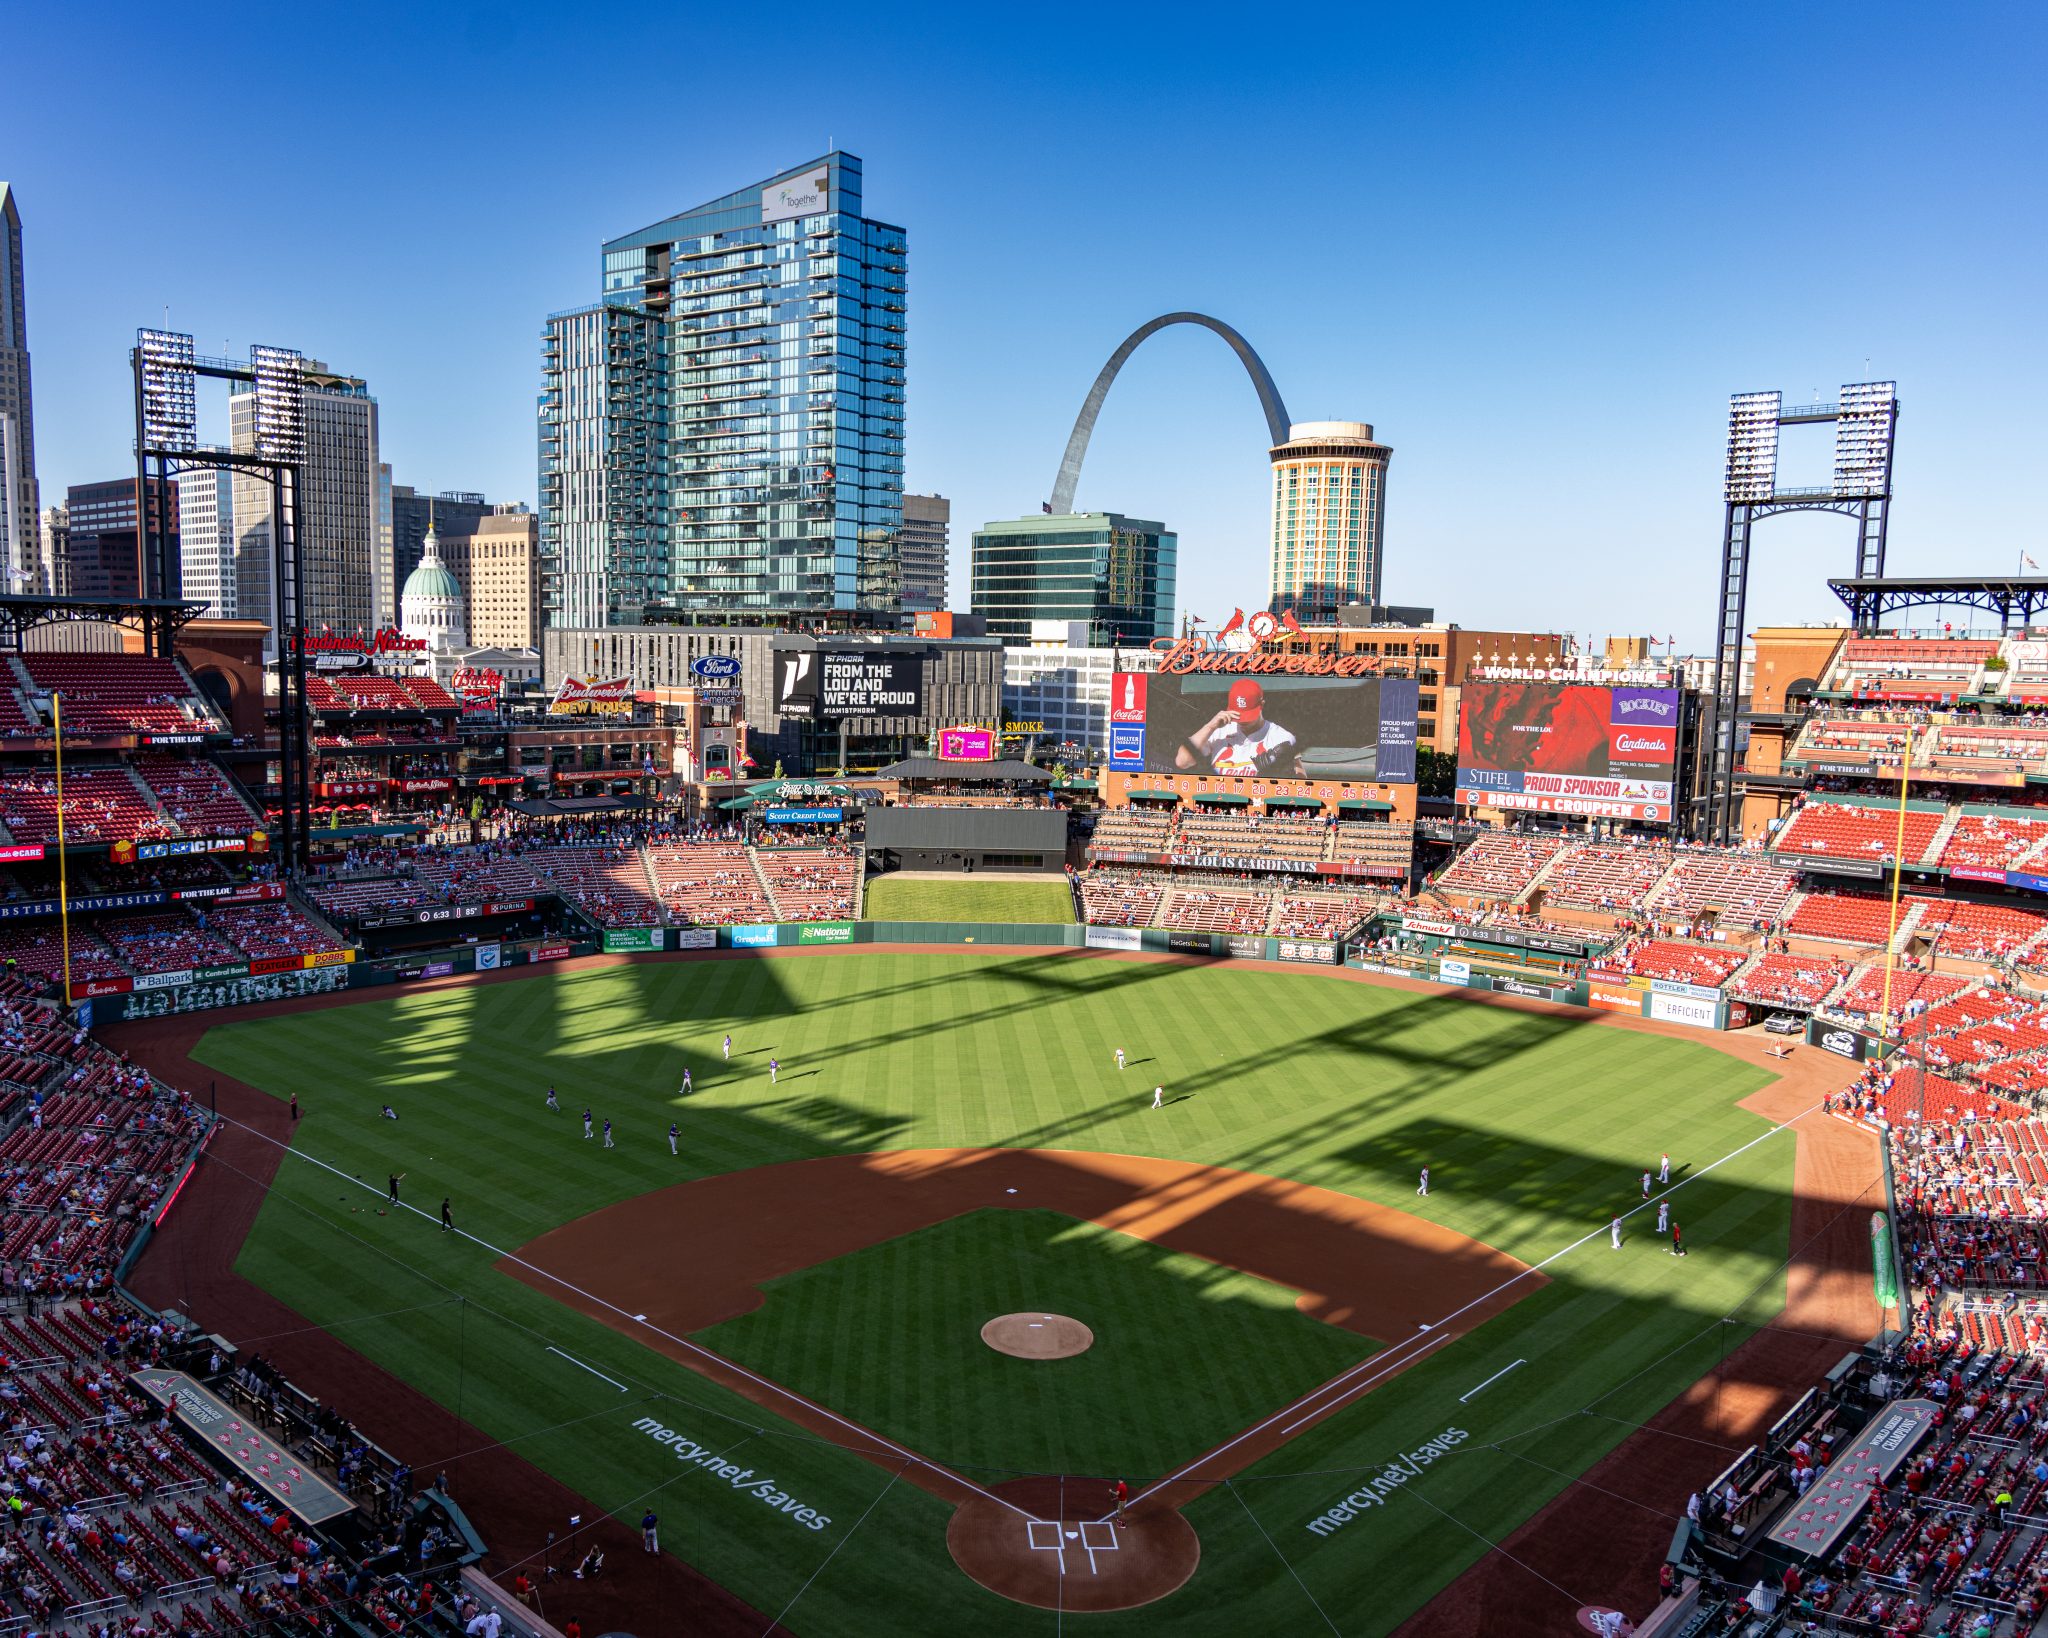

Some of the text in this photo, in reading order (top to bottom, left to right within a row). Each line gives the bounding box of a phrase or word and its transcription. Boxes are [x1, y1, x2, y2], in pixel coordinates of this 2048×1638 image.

[786, 195, 816, 208] Together
[365, 629, 427, 655] Nation
[1150, 637, 1382, 674] Budweiser
[703, 658, 734, 674] Ford
[824, 665, 892, 677] FROM THE
[1484, 666, 1658, 682] WORLD CHAMPIONS
[560, 684, 632, 699] Budweiser
[824, 679, 883, 691] LOU AND
[698, 688, 741, 698] Community
[824, 692, 915, 705] WE'RE PROUD
[552, 701, 633, 713] BREW HOUSE
[1619, 698, 1670, 716] ROCKIES
[1113, 709, 1145, 720] Coca-Cola
[1005, 721, 1044, 732] SMOKE
[152, 735, 204, 744] FOR THE LOU
[1616, 734, 1666, 752] Cardinals
[1837, 765, 1854, 773] THE
[1855, 766, 1873, 774] LOU
[1469, 768, 1511, 785] STIFEL
[1154, 781, 1161, 790] 2
[1168, 781, 1175, 791] 6
[1182, 781, 1189, 791] 9
[1197, 782, 1207, 792] 10
[1215, 783, 1225, 793] 14
[1234, 783, 1244, 794] 17
[1252, 784, 1267, 795] 20
[1275, 785, 1289, 796] 23
[1297, 786, 1311, 797] 24
[1319, 787, 1333, 798] 42
[1342, 788, 1357, 799] 45
[1362, 789, 1377, 800] 85
[1523, 776, 1562, 792] PROUD
[1563, 778, 1620, 797] SPONSOR
[1487, 793, 1538, 808] BROWN
[1541, 800, 1550, 809] &
[1554, 799, 1631, 816] CROUPPEN
[769, 812, 791, 820] SCOTT
[19, 849, 42, 857] CARE
[139, 839, 246, 860] BIG MAC LAND
[1170, 854, 1317, 873] ST. LOUIS CARDINALS
[181, 887, 232, 899] FOR THE LOU
[271, 887, 282, 897] 59
[65, 893, 162, 911] UNIVERSITY
[499, 902, 525, 911] PURINA
[433, 911, 450, 919] 6:33
[812, 926, 851, 937] National
[1406, 921, 1452, 934] Schnucks
[1472, 931, 1489, 939] 6:33
[1170, 940, 1210, 948] HeGetsUs.com
[315, 952, 345, 962] DOBBS
[205, 966, 248, 978] Central Bank
[255, 958, 298, 973] SEATGEEK
[1383, 967, 1410, 977] STADIUM
[147, 972, 191, 986] Ballpark
[1654, 983, 1686, 992] ROTTLER
[1822, 1033, 1854, 1053] Club
[1869, 1428, 1891, 1446] WORLD
[1881, 1418, 1918, 1451] CHAMPIONS
[632, 1416, 832, 1530] mercy.net/saves
[1305, 1426, 1470, 1537] mercy.net/saves
